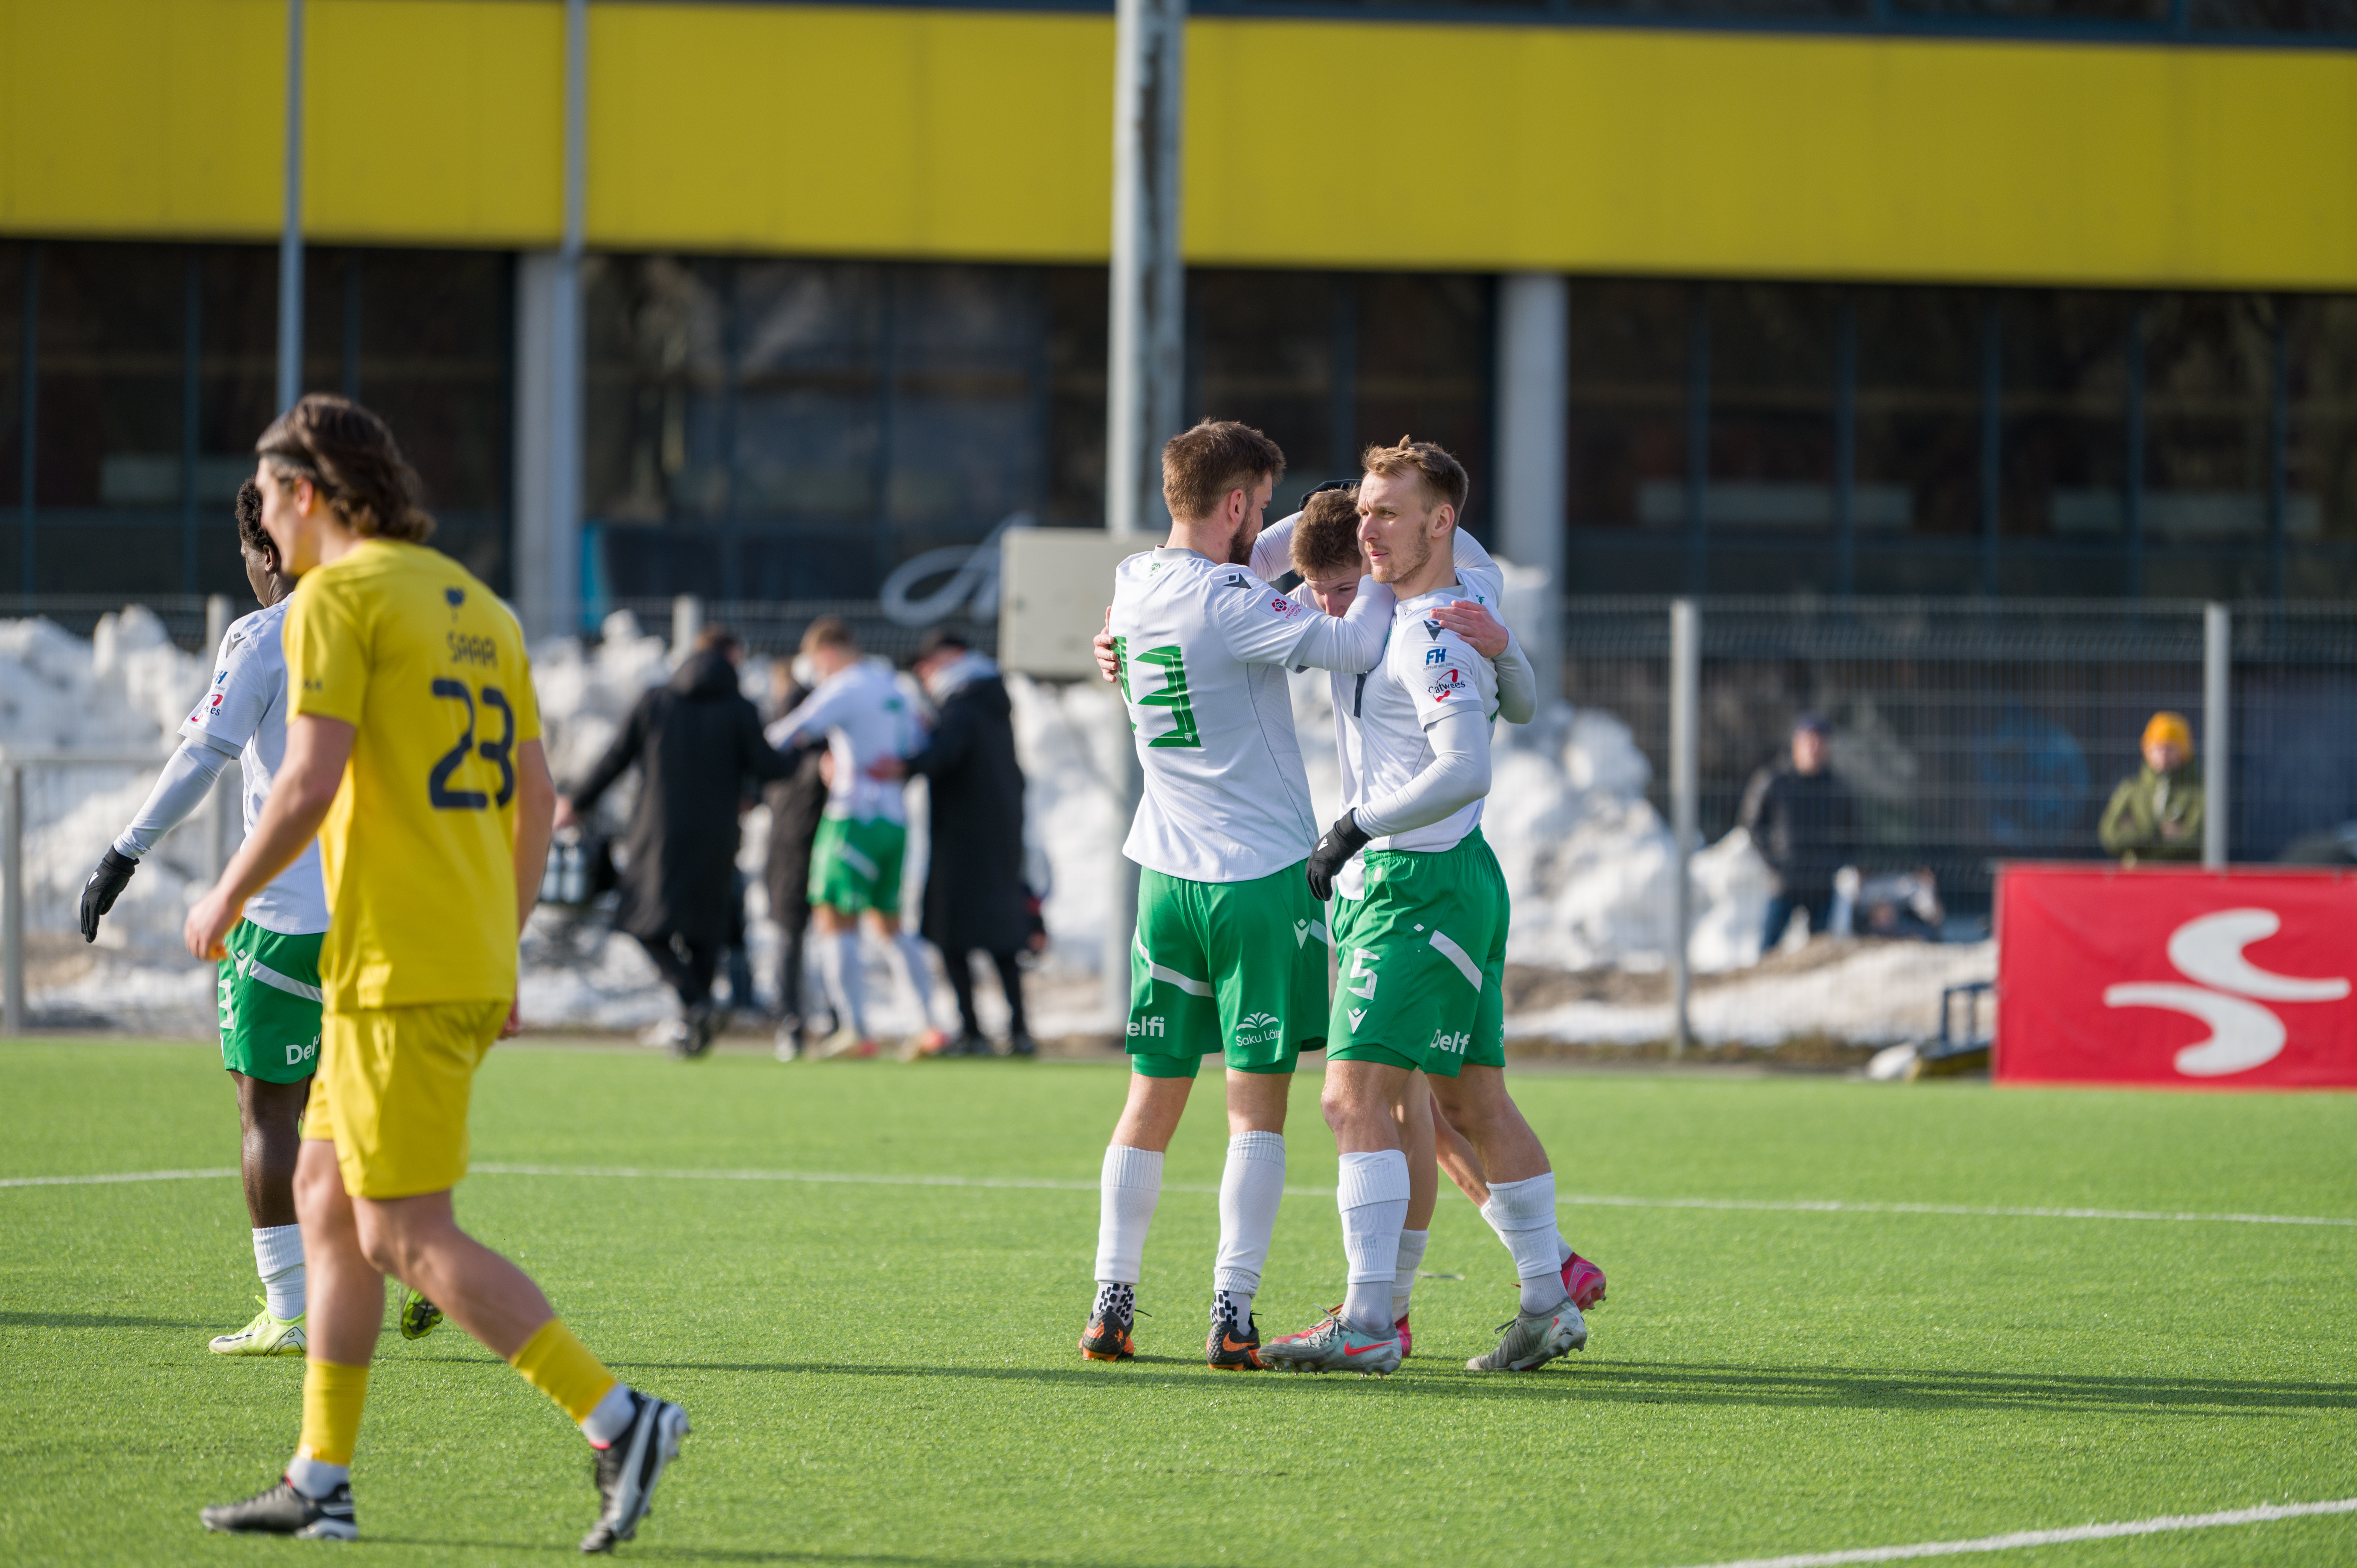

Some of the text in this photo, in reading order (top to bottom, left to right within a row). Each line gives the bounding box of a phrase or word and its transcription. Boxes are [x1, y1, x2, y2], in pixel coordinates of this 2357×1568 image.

[1286, 604, 1300, 619] PREMIUM
[1426, 648, 1447, 665] FH
[1428, 681, 1466, 694] Catwees
[429, 677, 515, 810] 23
[1347, 948, 1381, 1000] 5
[218, 979, 234, 1029] 3
[1127, 1016, 1164, 1037] elfi
[286, 1032, 321, 1065] Del
[1236, 1034, 1262, 1047] Saku
[1430, 1029, 1470, 1055] Delf
